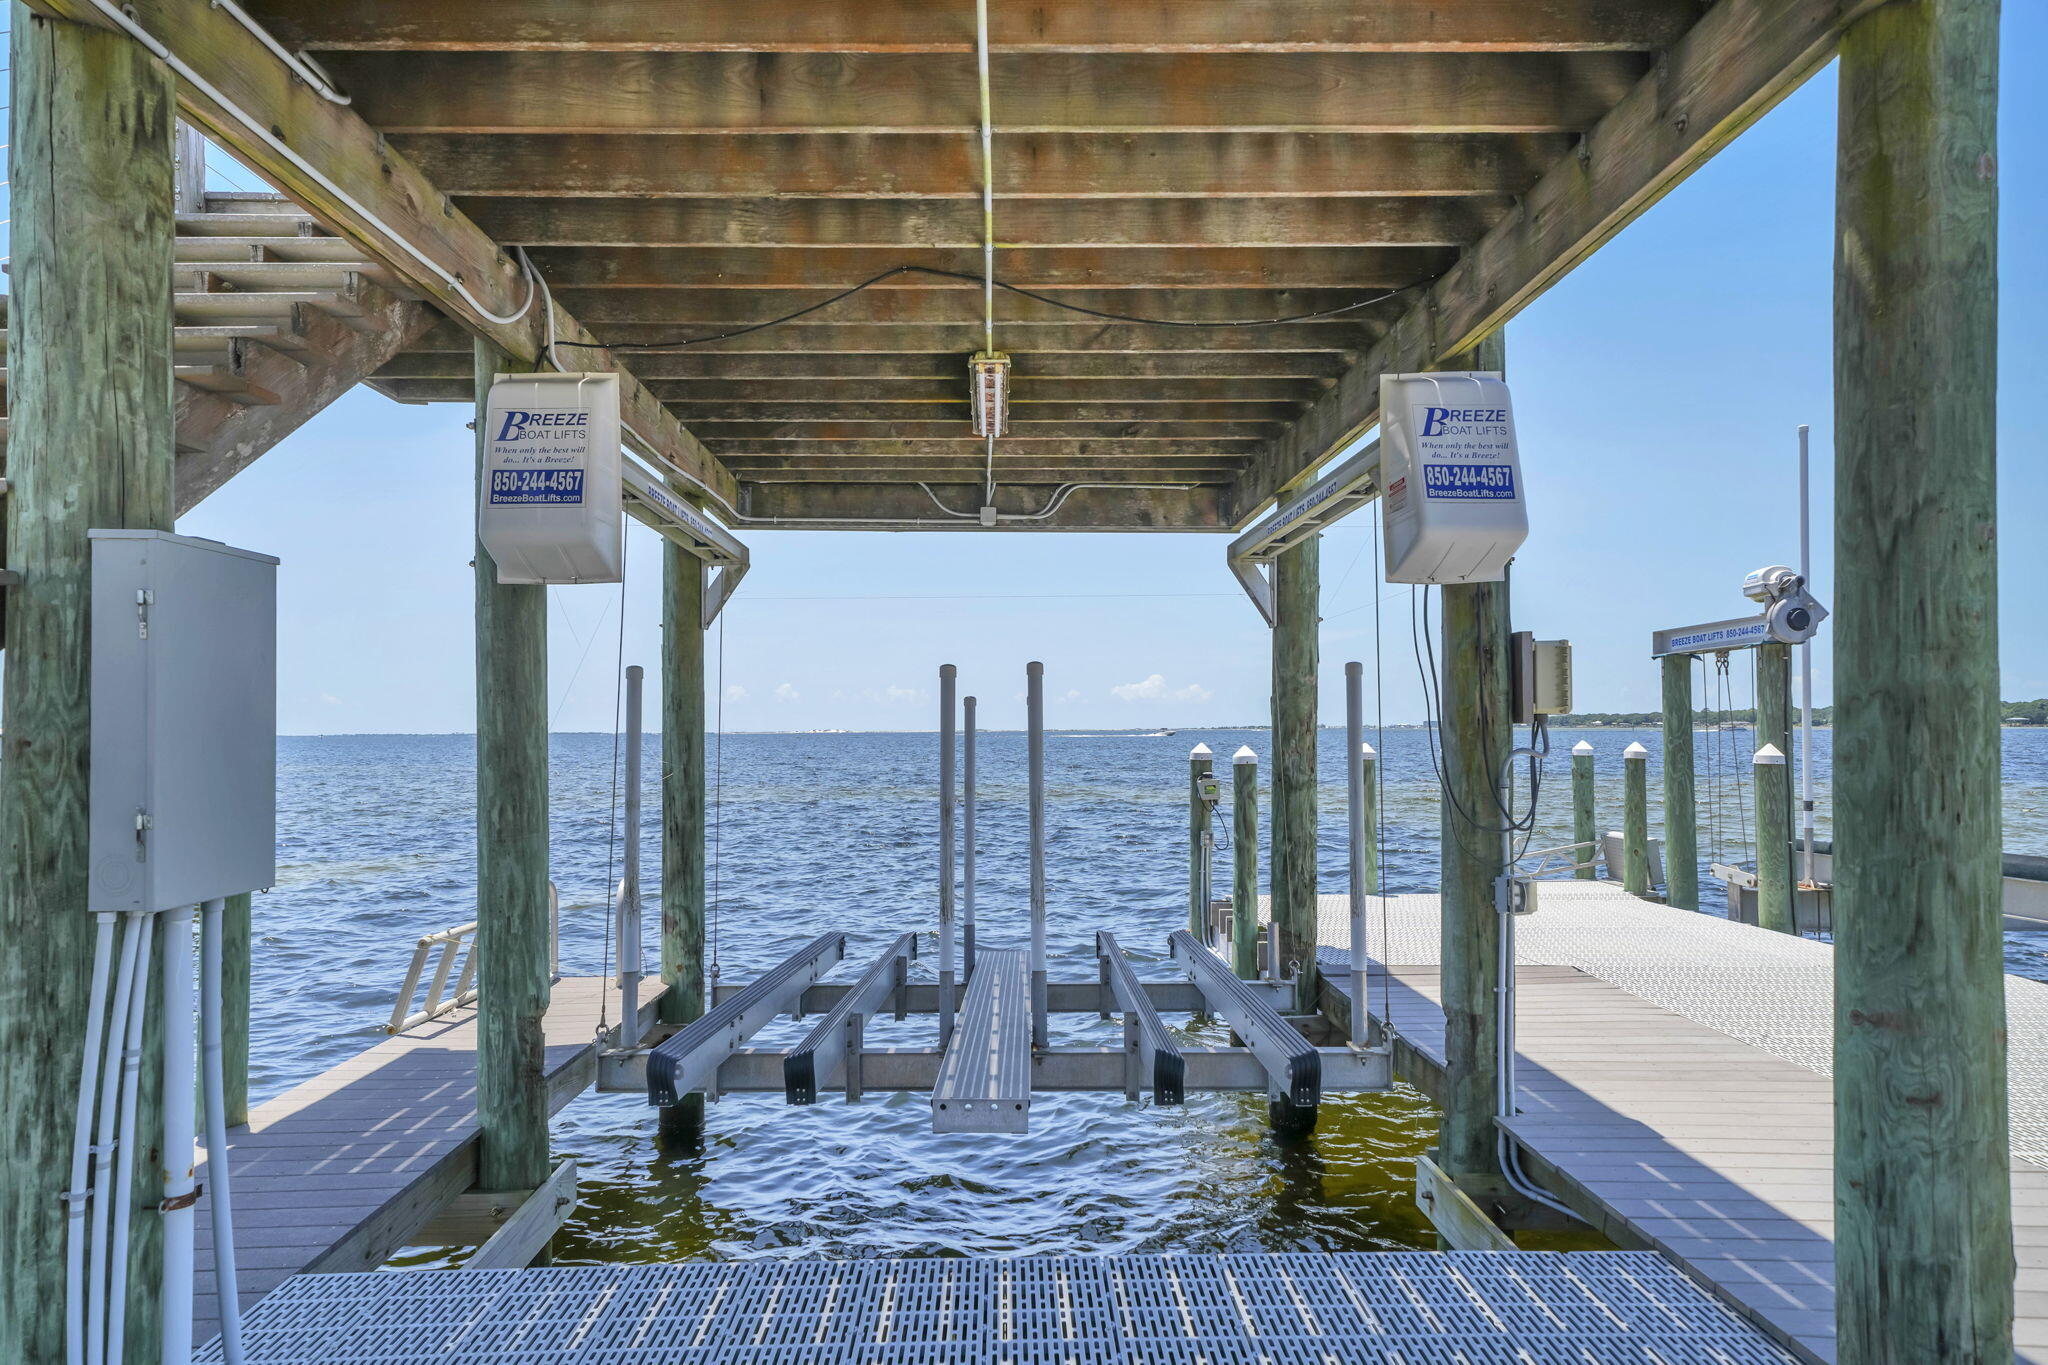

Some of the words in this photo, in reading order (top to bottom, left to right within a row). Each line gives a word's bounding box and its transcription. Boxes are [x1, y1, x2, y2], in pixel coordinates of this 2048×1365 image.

[494, 411, 589, 441] BREEZE
[1419, 407, 1506, 437] BREEZE
[519, 430, 551, 440] BOAT
[554, 430, 586, 440] LIFTS
[1442, 426, 1473, 435] BOAT
[1476, 426, 1507, 436] LIFTS
[519, 446, 536, 454] only
[1445, 442, 1462, 450] only
[1495, 442, 1509, 450] will
[522, 456, 535, 464] It's
[545, 456, 575, 464] Breeze!
[494, 471, 582, 491] 850-244-4567
[1426, 466, 1511, 487] 850-244-4567
[493, 494, 580, 503] BreezeBoatLifts.com
[1429, 489, 1513, 498] BreezeBoatLifts.com
[1671, 636, 1692, 647] BREEZE
[1692, 633, 1707, 644] BOAT
[1707, 630, 1724, 642] LIFTS
[1726, 624, 1765, 639] 850-244-4567
